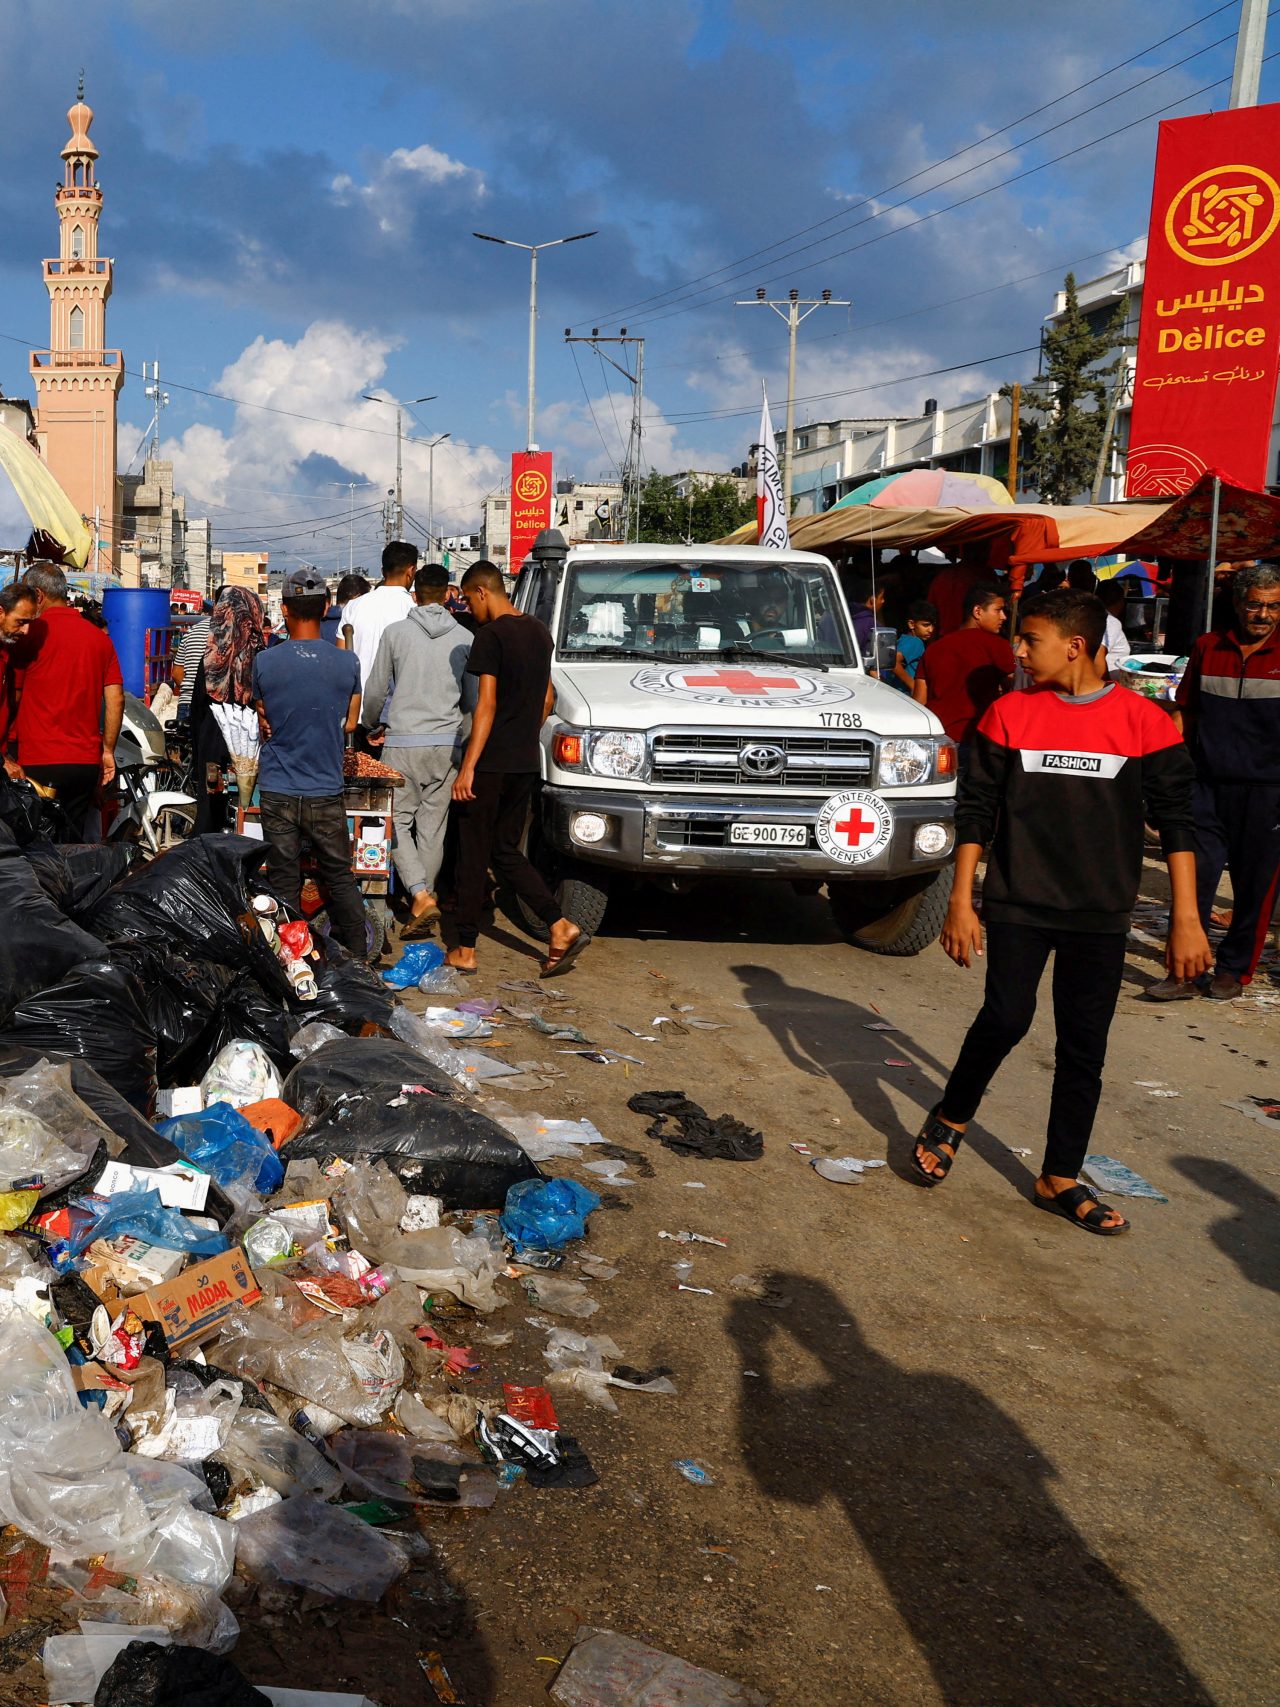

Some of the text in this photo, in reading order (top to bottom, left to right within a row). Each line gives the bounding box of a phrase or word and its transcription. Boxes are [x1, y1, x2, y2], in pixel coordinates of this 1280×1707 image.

[1156, 279, 1266, 317] ديليس
[1157, 324, 1266, 353] Dèlice
[694, 694, 821, 707] GENEVE
[819, 713, 863, 728] 17788
[1045, 755, 1098, 770] FASHION
[838, 792, 891, 846] INTERNATIONAL
[829, 846, 875, 862] GENEVE
[109, 1170, 119, 1193] DORCO
[186, 1279, 233, 1318] MADAR
